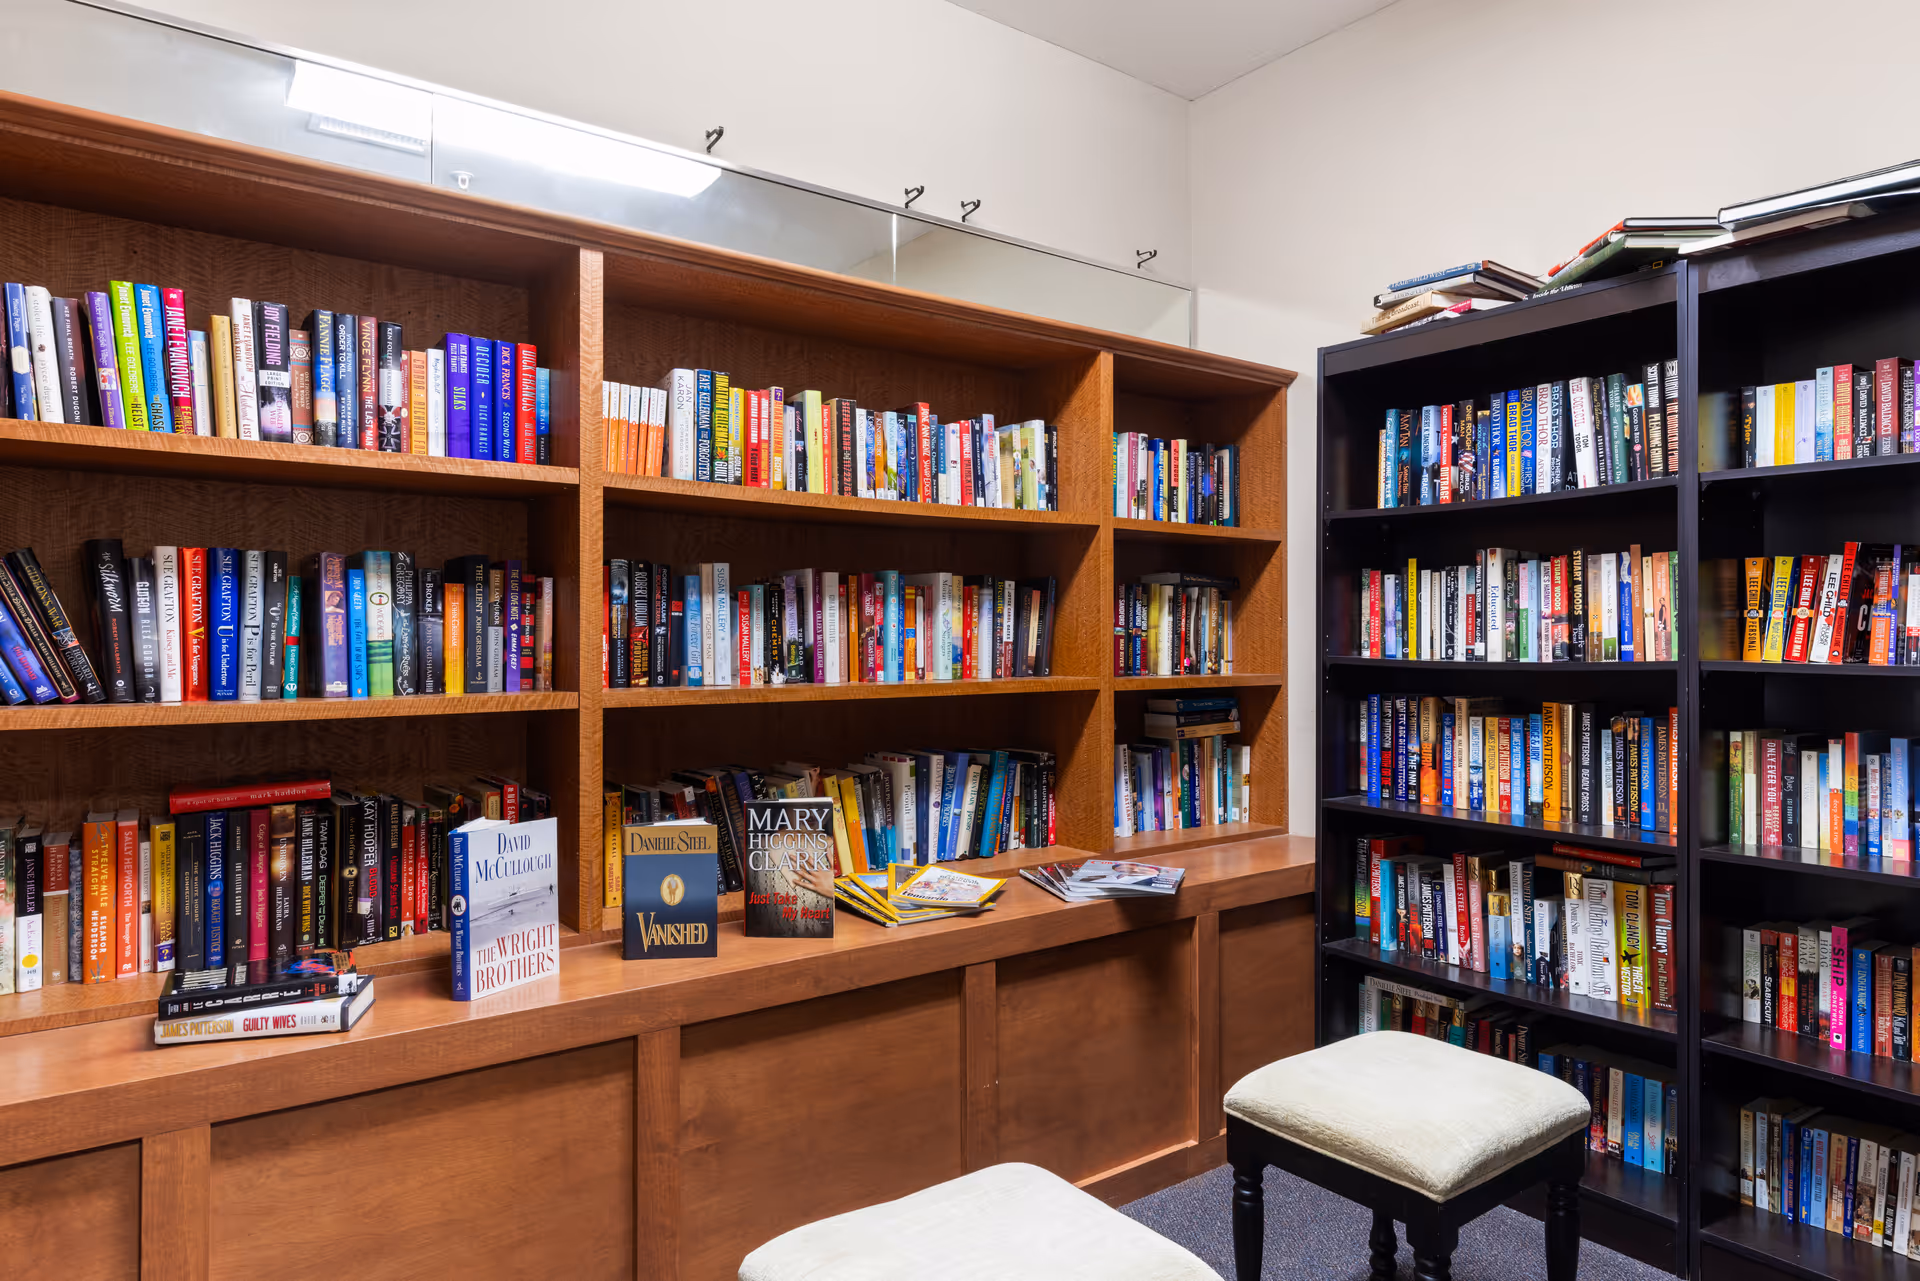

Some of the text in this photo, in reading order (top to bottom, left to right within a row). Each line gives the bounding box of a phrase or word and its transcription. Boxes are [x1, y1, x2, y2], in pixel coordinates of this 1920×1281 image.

[65, 319, 73, 336] FINAL
[264, 306, 288, 365] JOY FIELDING
[117, 285, 144, 428] Janet Evanovich LEE GOLDBERG HEIST
[140, 288, 166, 431] Janet Evanovich LEE GOLDBERG CHASE
[165, 305, 191, 398] JANET EVANOVICH
[319, 314, 334, 392] FANNIE FLAGG
[339, 351, 346, 361] TO
[69, 366, 79, 394] ROBERT
[362, 321, 374, 446] VINCE FLYNN THE LAST MAN
[453, 386, 466, 410] SILKS
[71, 396, 81, 423] DUGONI
[501, 346, 511, 458] DICK FRANCIS SECOND WIND
[1881, 382, 1891, 435] DAVID BALDACCI
[699, 374, 710, 480] FAYE KELLERMAN FORGOTTEN
[714, 374, 728, 482] JONATHAN KELLERMAN GUILT
[1508, 405, 1517, 452] BRAD THOR
[842, 460, 851, 496] 11/22/63
[1440, 467, 1449, 500] OUTRAGE
[191, 555, 202, 574] SUE
[247, 553, 259, 572] SUE
[510, 569, 519, 579] THE
[136, 581, 151, 614] GIDEON
[191, 575, 203, 623] GRAFTON
[247, 575, 259, 621] GRAFTON
[396, 562, 407, 605] GREGORY
[405, 570, 414, 605] PHILIPPA
[510, 580, 519, 591] LAST
[510, 592, 519, 605] LOVE
[634, 571, 648, 627] ROBERT LUDLUM
[717, 568, 726, 633] SUSAN MALLERY
[1573, 550, 1582, 615] STUART WOODS
[98, 564, 124, 612] Silkworm
[113, 643, 122, 674] GALBRAITH
[510, 606, 519, 620] NOTE
[1490, 585, 1499, 631] Educated
[1747, 577, 1759, 652] LEE CHILD PERSONAL
[188, 626, 204, 639] V
[244, 624, 260, 636] P
[510, 633, 518, 651] EMMA
[193, 645, 201, 653] for
[246, 648, 257, 662] for
[633, 641, 642, 676] PROTOCOL
[191, 654, 201, 686] Vengeance
[246, 664, 258, 687] Peril
[1543, 706, 1553, 790] JAMES PATTERSON
[1767, 742, 1776, 802] ONLY EVER YOU
[250, 788, 307, 800] mark haddon
[1581, 792, 1589, 812] CROSS
[320, 820, 328, 841] TAMI
[748, 808, 830, 831] MARY
[279, 838, 287, 881] UNBROKEN
[363, 800, 377, 897] KAY HOOPER BLOOD
[497, 832, 532, 856] DAVID
[630, 830, 711, 854] DANIELLE STEEL
[748, 833, 827, 849] HIGGINS
[100, 844, 108, 907] TWELVE-MILE
[124, 831, 132, 907] SALLY HEPWORTH
[748, 850, 830, 872] CLARK
[26, 858, 35, 913] JANE HELLER
[209, 818, 224, 953] JACK HIGGINS ROUGH JUSTICE
[748, 891, 798, 905] Just Take
[636, 911, 709, 953] VANISHED
[782, 906, 830, 921] My Heart
[1626, 889, 1640, 950] TOM CLANCY
[90, 910, 99, 960] HENDERSON
[99, 916, 107, 953] ELEANOR
[476, 923, 556, 968] THE WRIGHT
[476, 949, 555, 994] BROTHERS
[1621, 966, 1631, 995] VECTOR
[1632, 965, 1643, 995] THREAT
[1657, 957, 1668, 1002] Red Rabbit
[1832, 947, 1845, 986] SHIP
[1764, 976, 1772, 1024] SEABISCUIT
[160, 1014, 296, 1039] JAMES PATTERSON GUILTY WIVES
